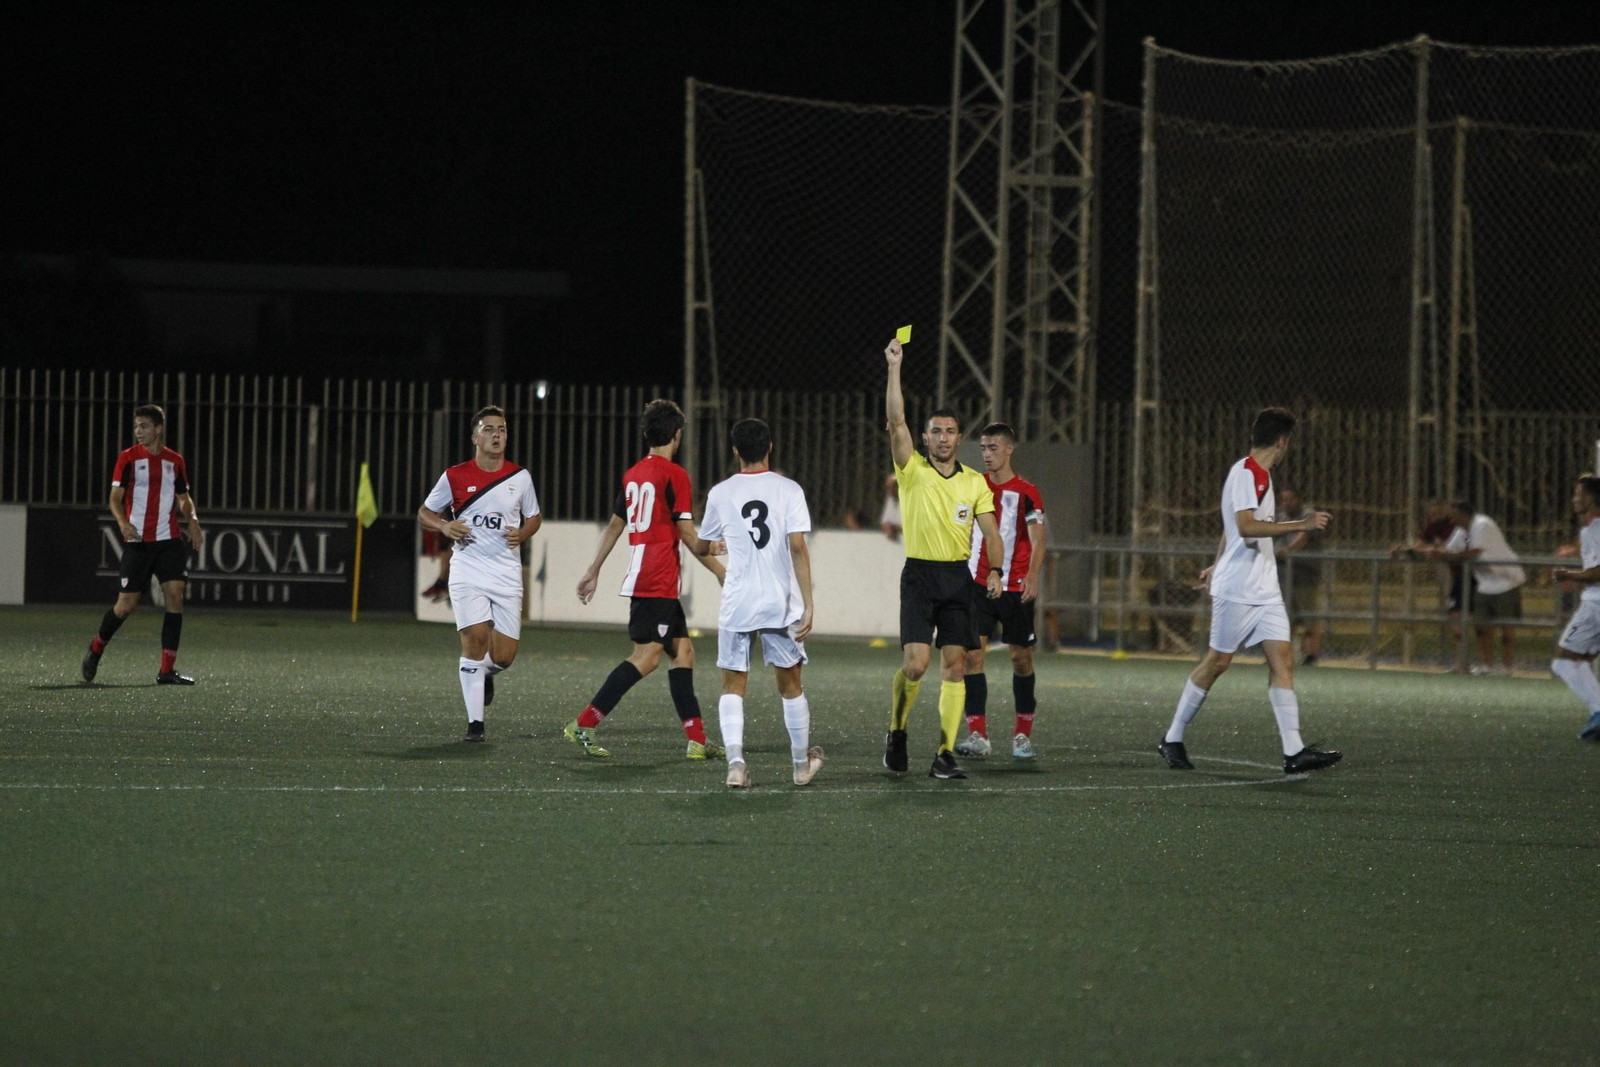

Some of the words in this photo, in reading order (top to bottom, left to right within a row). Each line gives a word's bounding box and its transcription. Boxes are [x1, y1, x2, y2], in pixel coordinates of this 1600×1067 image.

[472, 514, 502, 530] CASI
[625, 481, 655, 533] 20
[741, 500, 771, 549] 3
[98, 526, 345, 574] NIONAL
